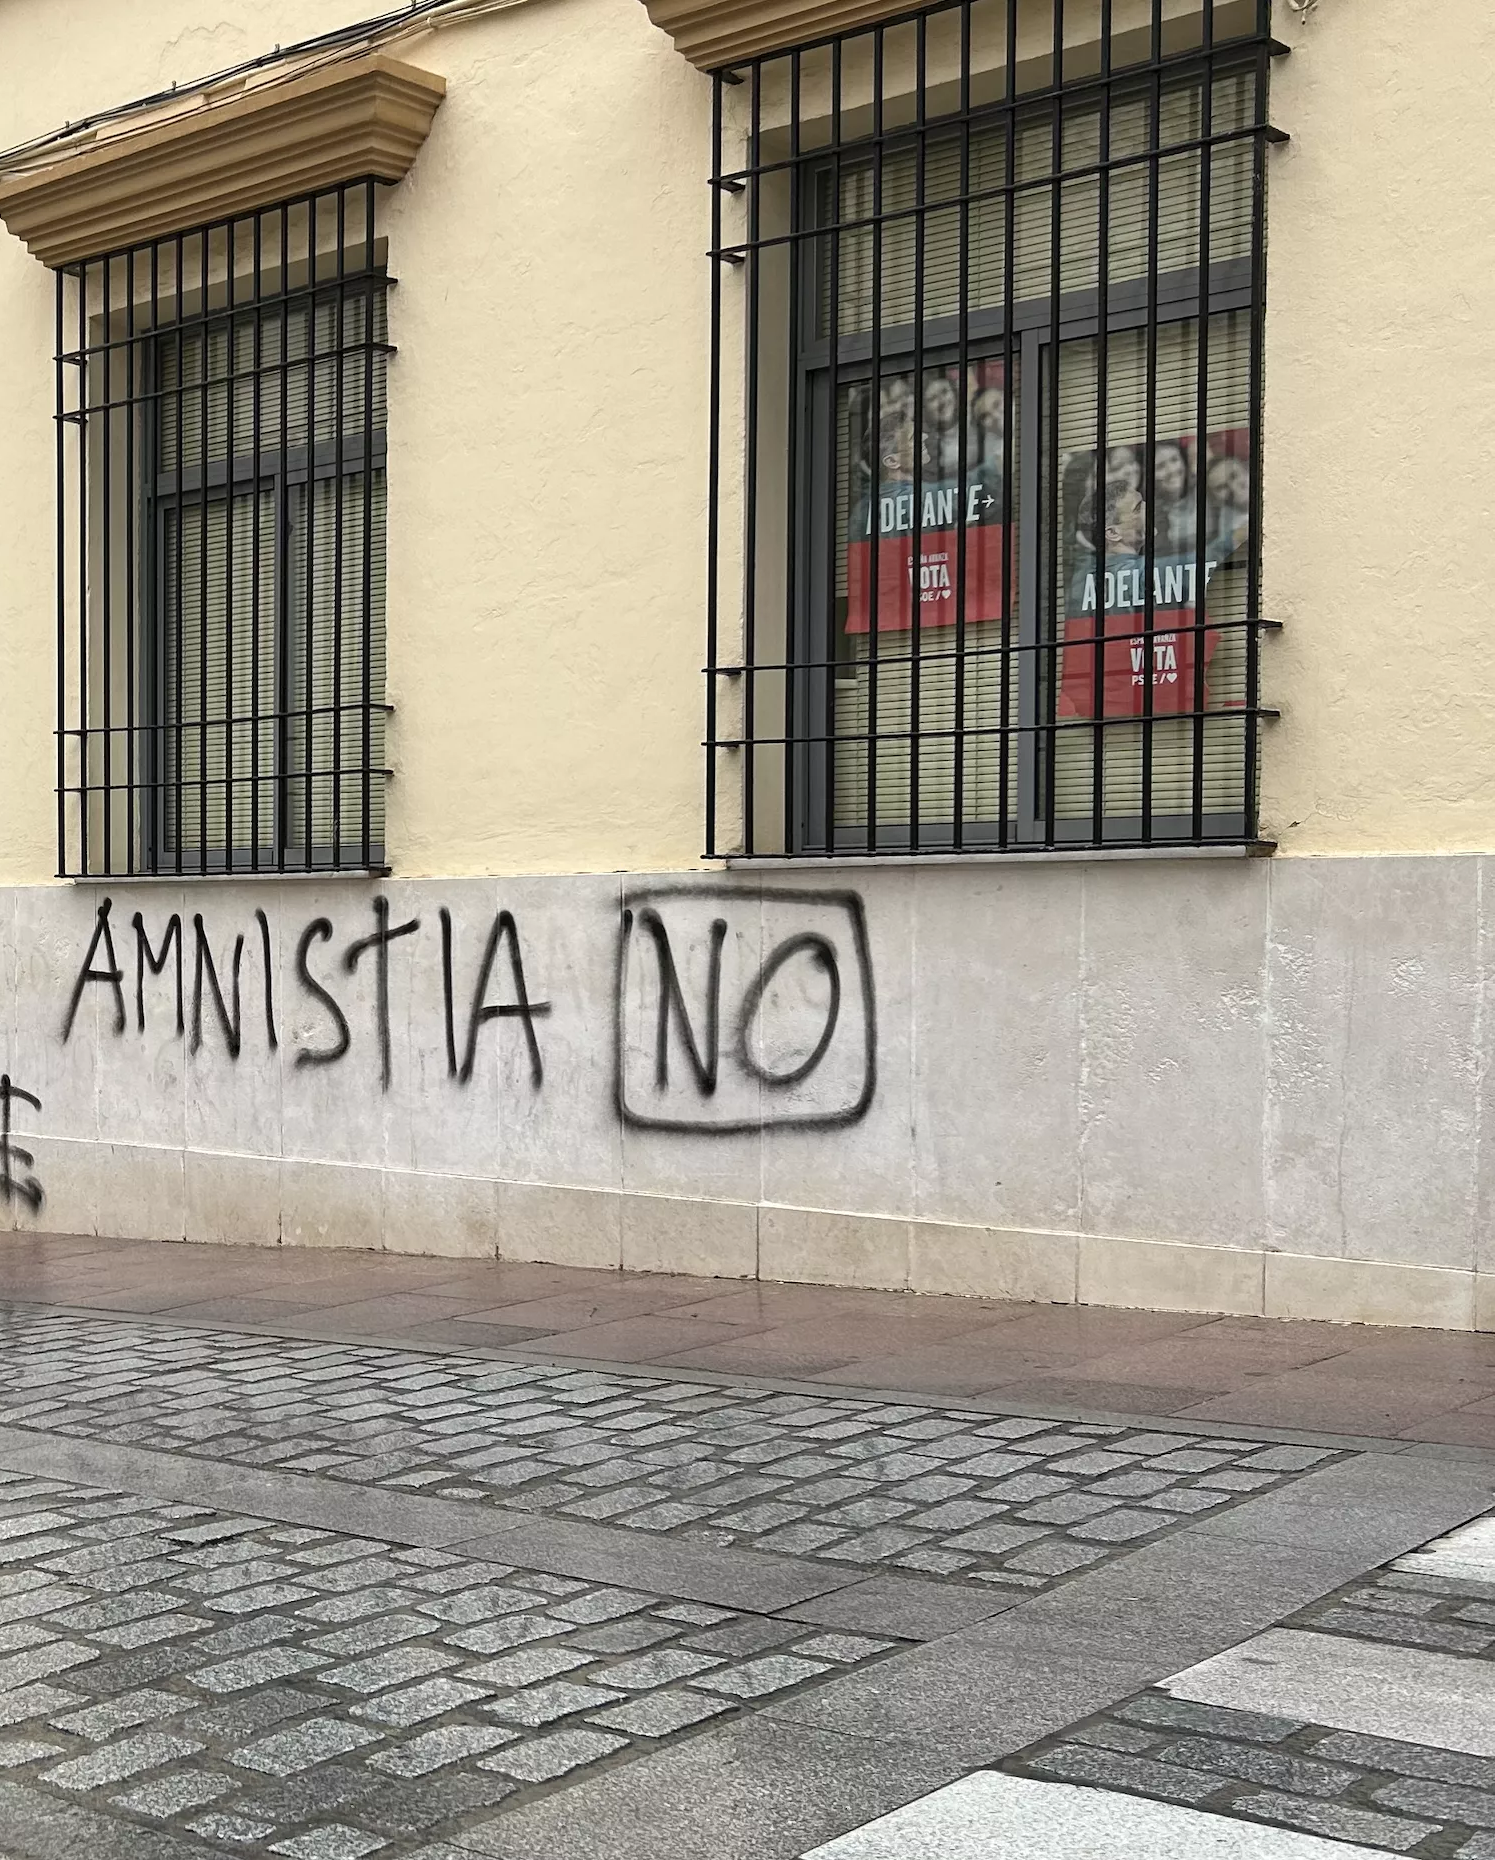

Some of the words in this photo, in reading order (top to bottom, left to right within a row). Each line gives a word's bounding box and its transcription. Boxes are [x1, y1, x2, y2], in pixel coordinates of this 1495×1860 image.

[866, 485, 983, 534] DEANE
[1130, 645, 1177, 672] VTA
[1132, 673, 1158, 685] PSE
[60, 895, 553, 1095] AMNISTIA
[636, 907, 840, 1097] NO
